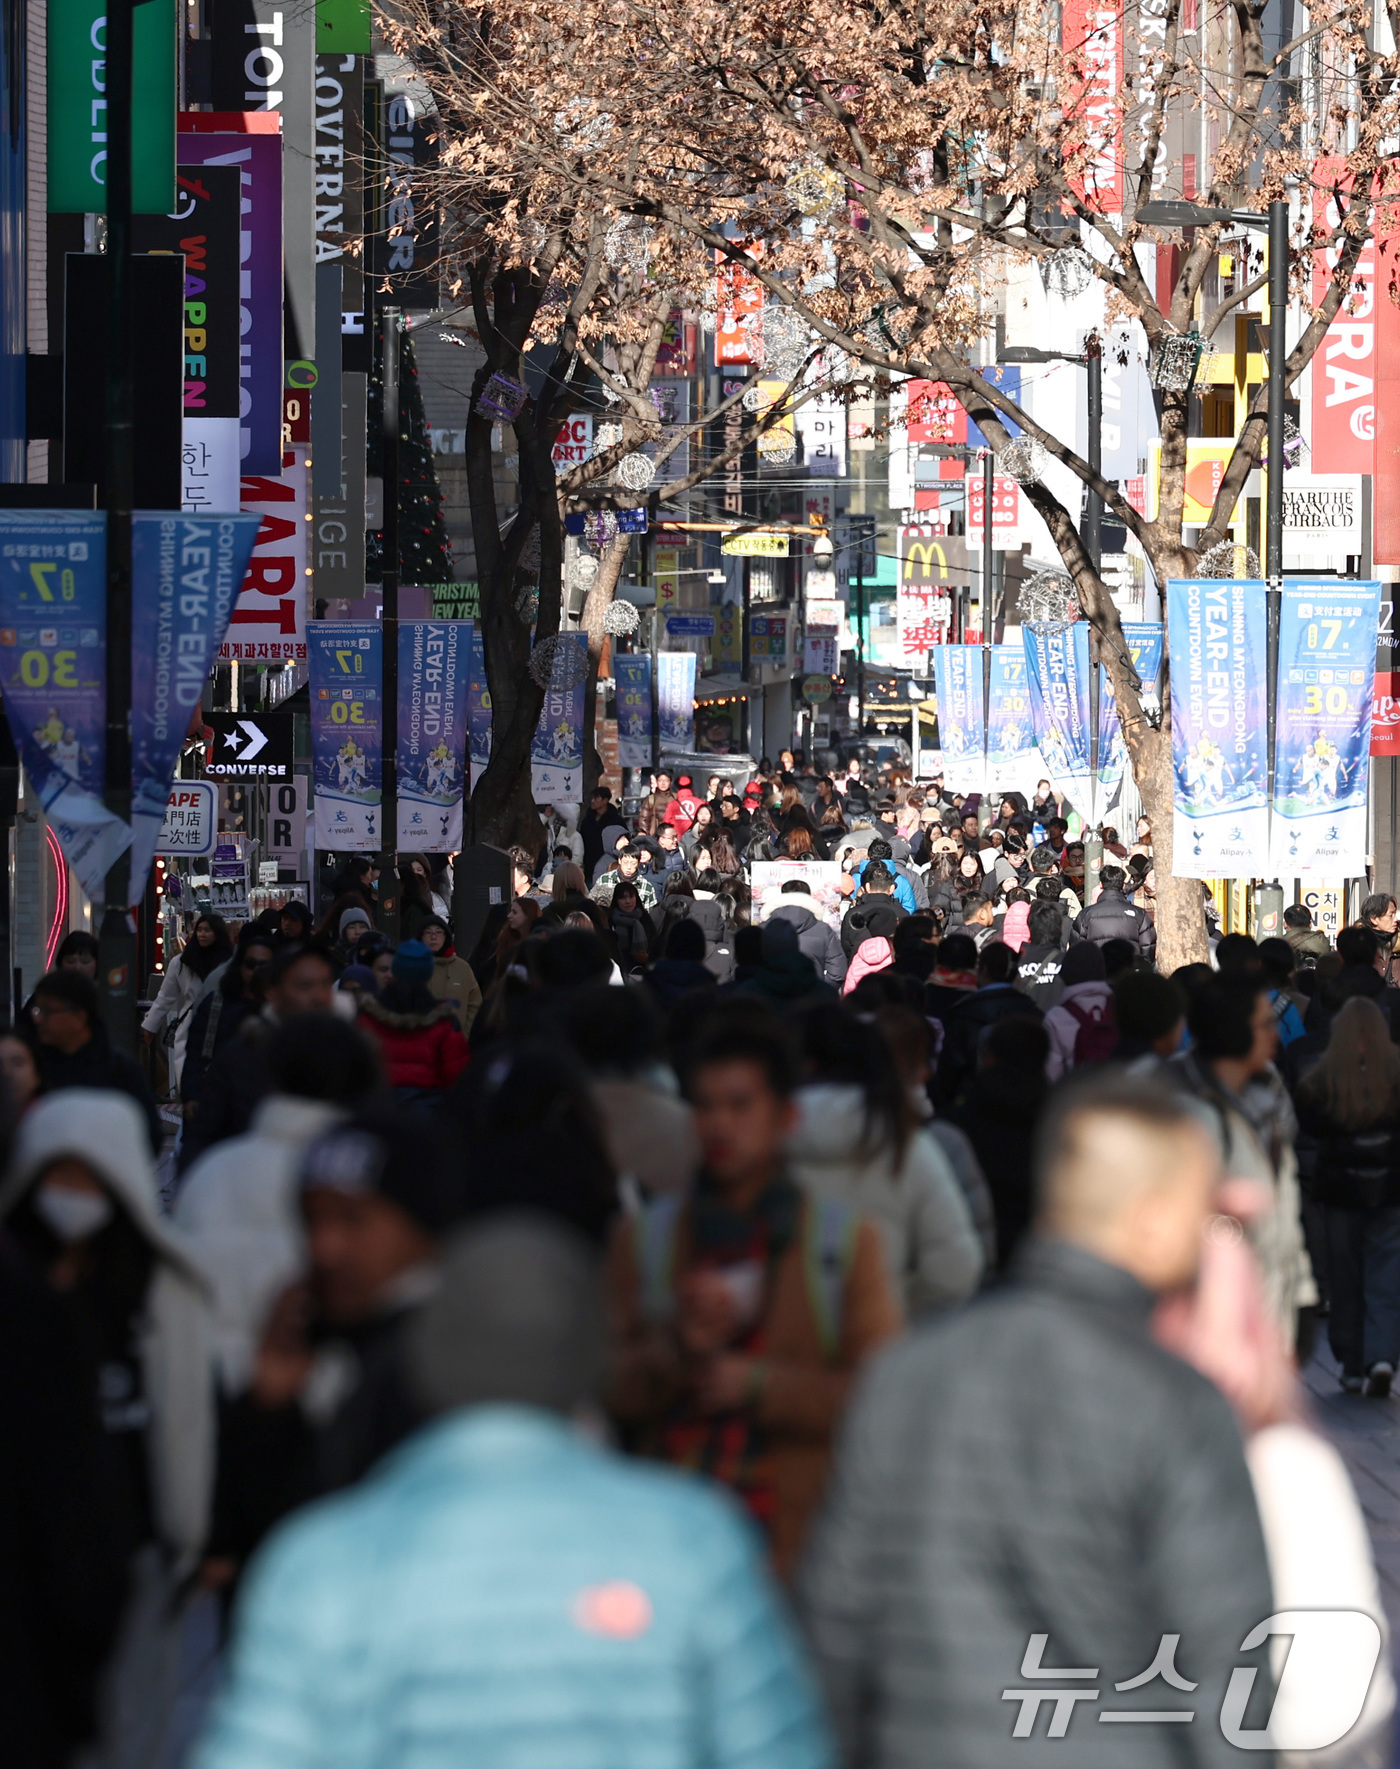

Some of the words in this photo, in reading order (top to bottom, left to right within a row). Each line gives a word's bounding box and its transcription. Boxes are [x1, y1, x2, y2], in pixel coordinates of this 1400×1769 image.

[180, 235, 207, 407] WAPPEN
[556, 420, 587, 443] BC
[551, 445, 587, 461] ART
[1283, 514, 1353, 527] GIRBAUD
[724, 539, 750, 549] CCTV
[457, 602, 481, 619] YEA
[1232, 586, 1245, 644] SHINING
[1314, 606, 1363, 617] 支付宝活动
[1188, 585, 1202, 681] COUNTDOWN
[1320, 619, 1343, 650] 7
[219, 643, 307, 659] 세계과자할인점
[1205, 586, 1230, 728] YEAR-END
[952, 648, 965, 718] YEAR-END
[1190, 684, 1203, 729] EVENT
[1233, 648, 1246, 753] MYEONGDONG
[1303, 685, 1348, 715] 30
[205, 764, 287, 776] CONVERSE
